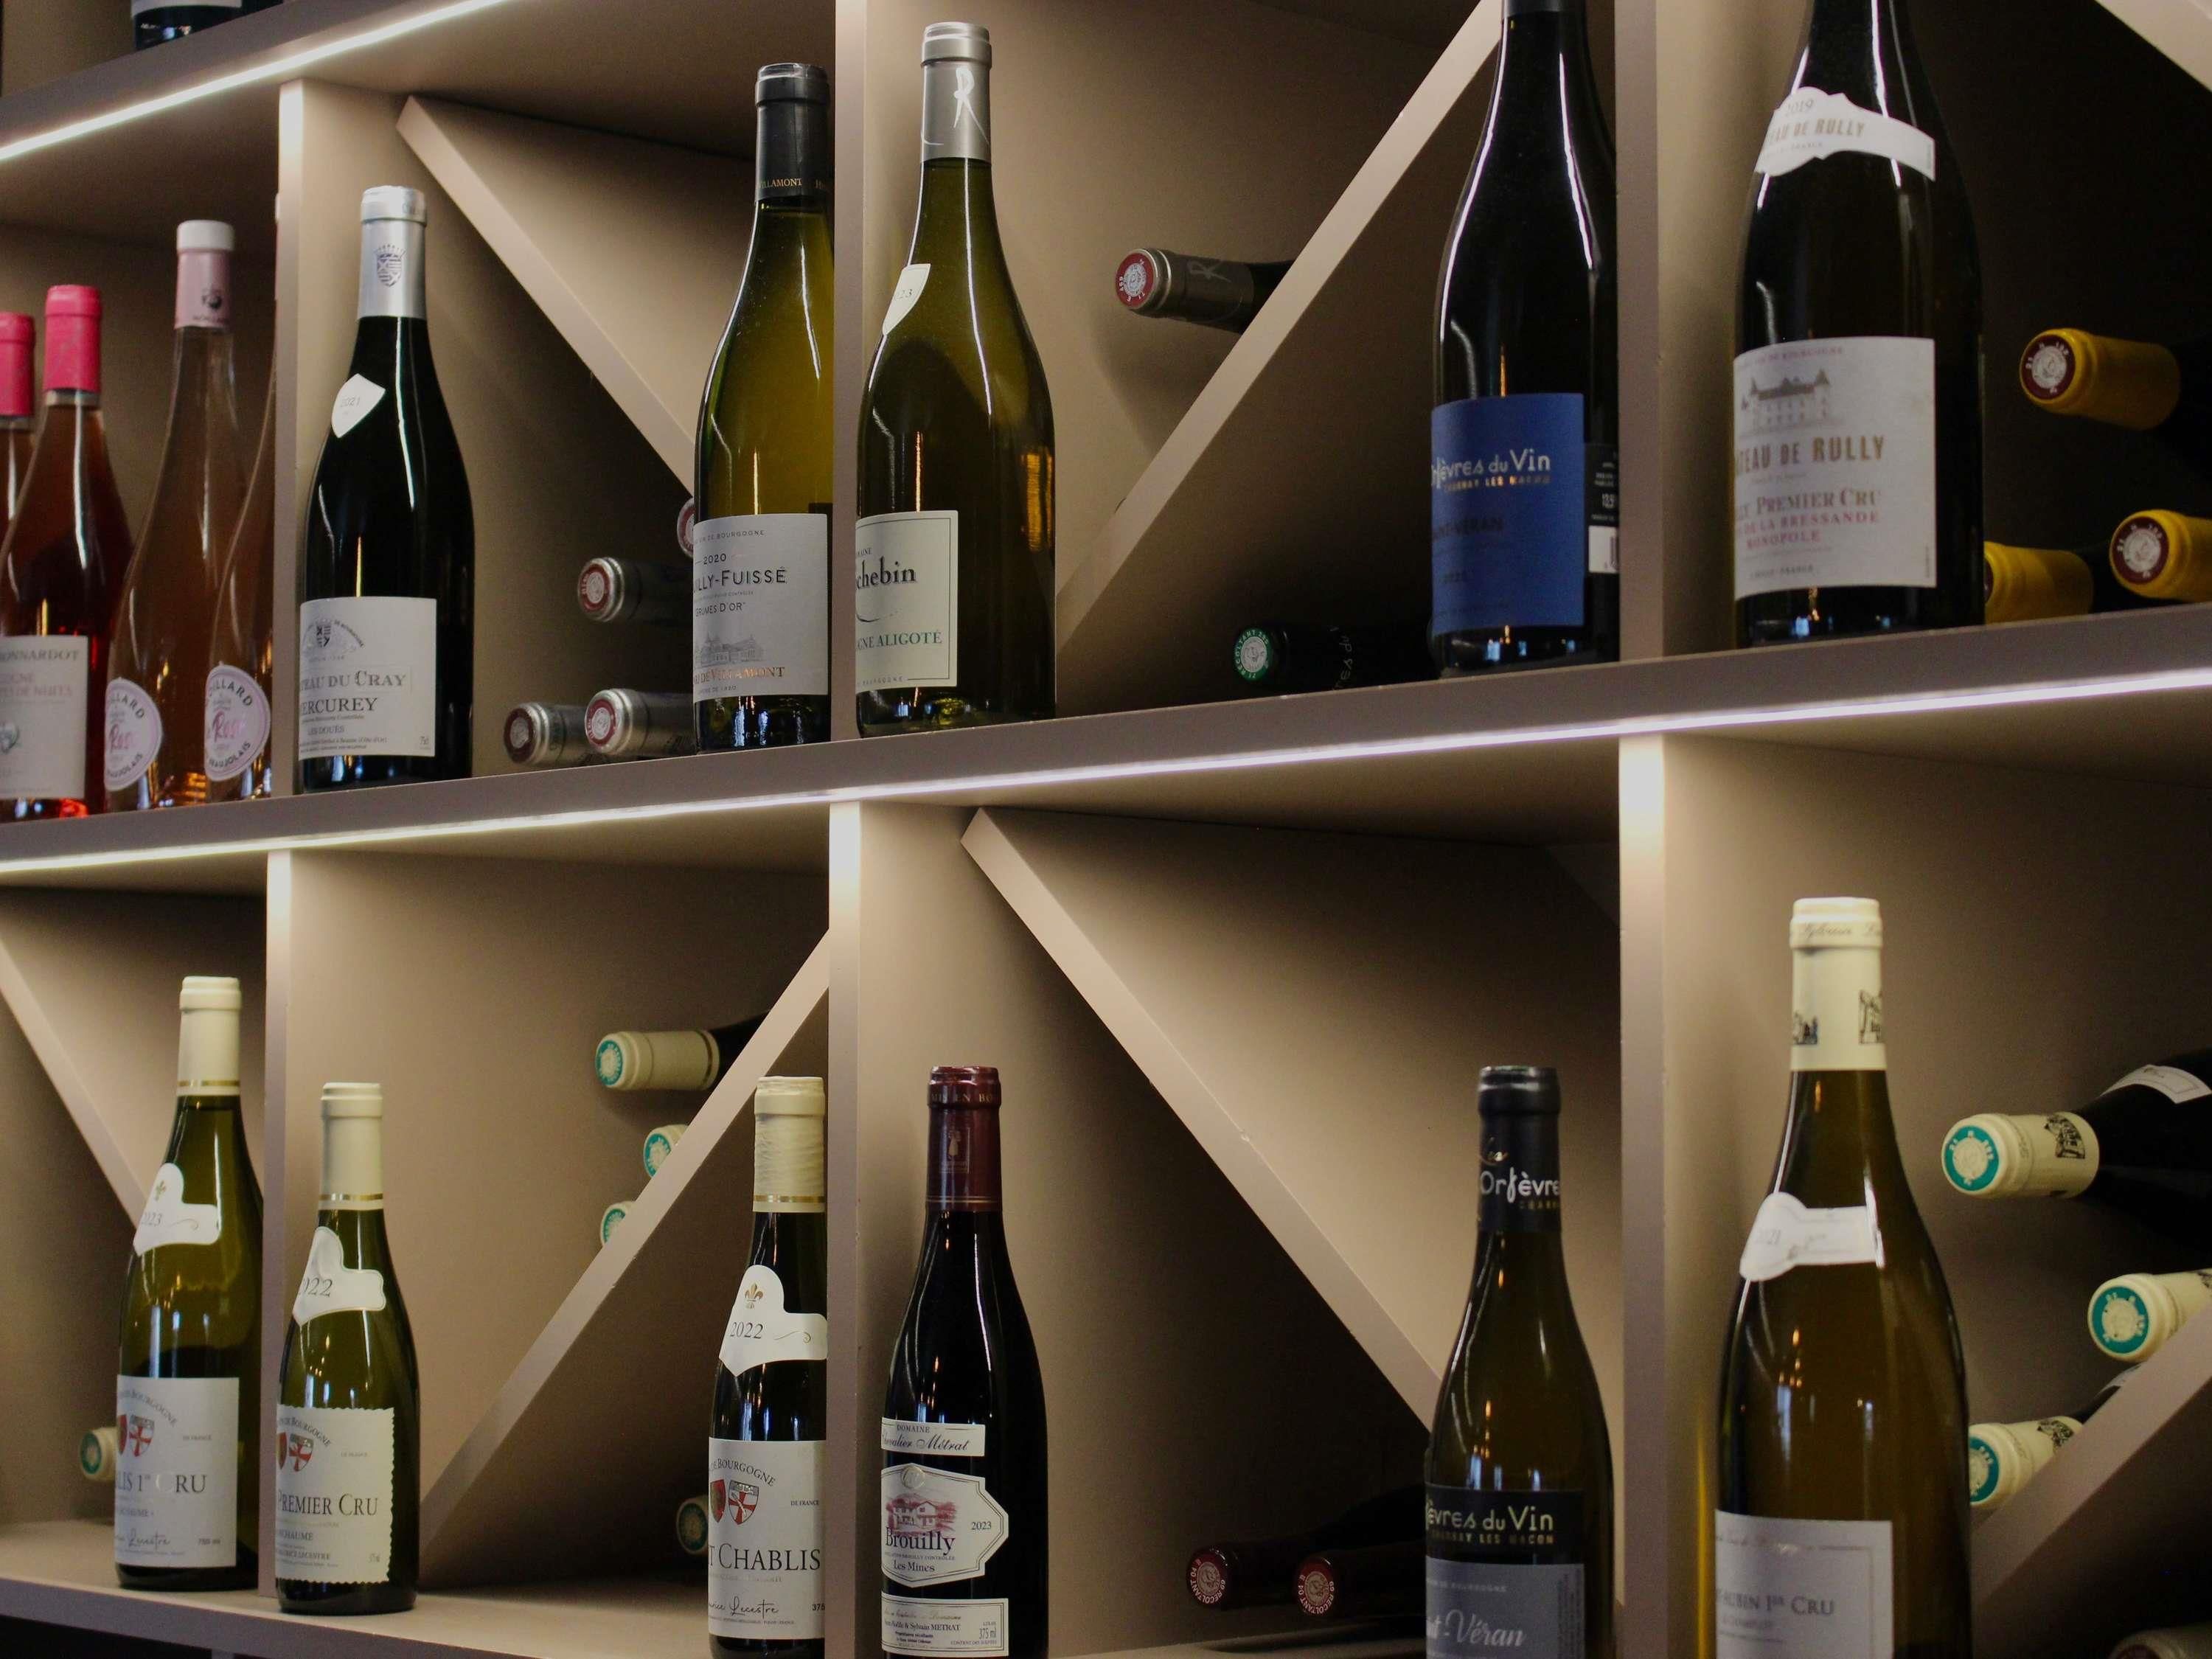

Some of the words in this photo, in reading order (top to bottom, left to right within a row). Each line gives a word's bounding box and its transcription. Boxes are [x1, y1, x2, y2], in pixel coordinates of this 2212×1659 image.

[1794, 122, 1809, 136] DE
[1815, 118, 1865, 138] RULLY
[1781, 442, 1800, 466] DE
[1812, 435, 1885, 462] RULLY
[1489, 453, 1509, 474] du
[1510, 448, 1551, 472] Vin
[703, 553, 727, 565] 2020
[877, 629, 942, 647] ALIGOTÉ
[329, 675, 350, 688] DU
[355, 669, 406, 687] CRAY
[301, 697, 379, 715] ERCUREY
[730, 1321, 764, 1340] 2022
[291, 1416, 331, 1447] BOURGOGNE
[896, 1424, 931, 1434] DOMAINE
[717, 1458, 776, 1488] BOURGOGNE
[338, 1492, 378, 1516] CRU
[971, 1520, 992, 1531] 2023
[1482, 1509, 1506, 1531] du
[1508, 1505, 1554, 1531] Vin
[885, 1526, 956, 1556] Brouilly
[1479, 1533, 1501, 1544] LES
[718, 1543, 821, 1571] CHABLIS
[893, 1559, 907, 1571] Les
[908, 1561, 936, 1572] Mines
[1792, 1595, 1834, 1615] CRU
[978, 1627, 990, 1640] 375
